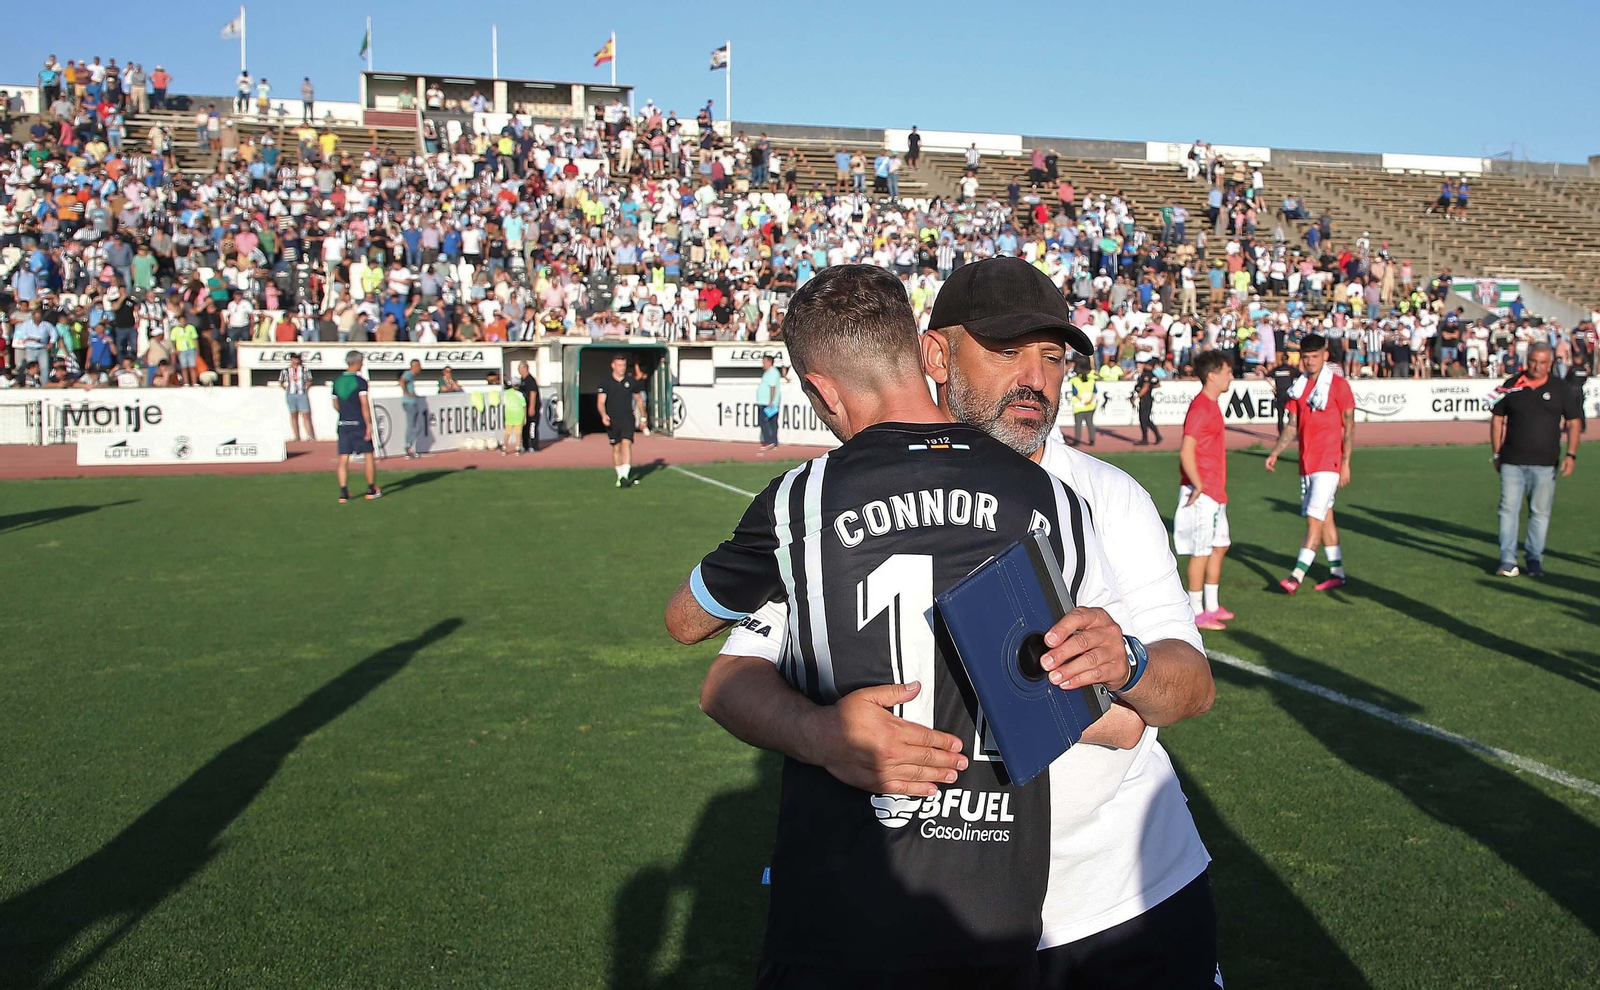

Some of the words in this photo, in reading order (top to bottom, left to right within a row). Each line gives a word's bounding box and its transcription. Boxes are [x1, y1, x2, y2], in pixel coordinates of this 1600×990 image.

[425, 351, 484, 361] LEGEA
[1154, 391, 1196, 404] Guada
[63, 399, 163, 433] Monje
[440, 403, 506, 436] FEDERACI
[735, 403, 831, 431] FEDACIO
[104, 447, 149, 459] LOTUS
[215, 445, 258, 456] LOTUS
[833, 488, 999, 549] CONNOR
[920, 819, 1011, 842] Gasolineras
